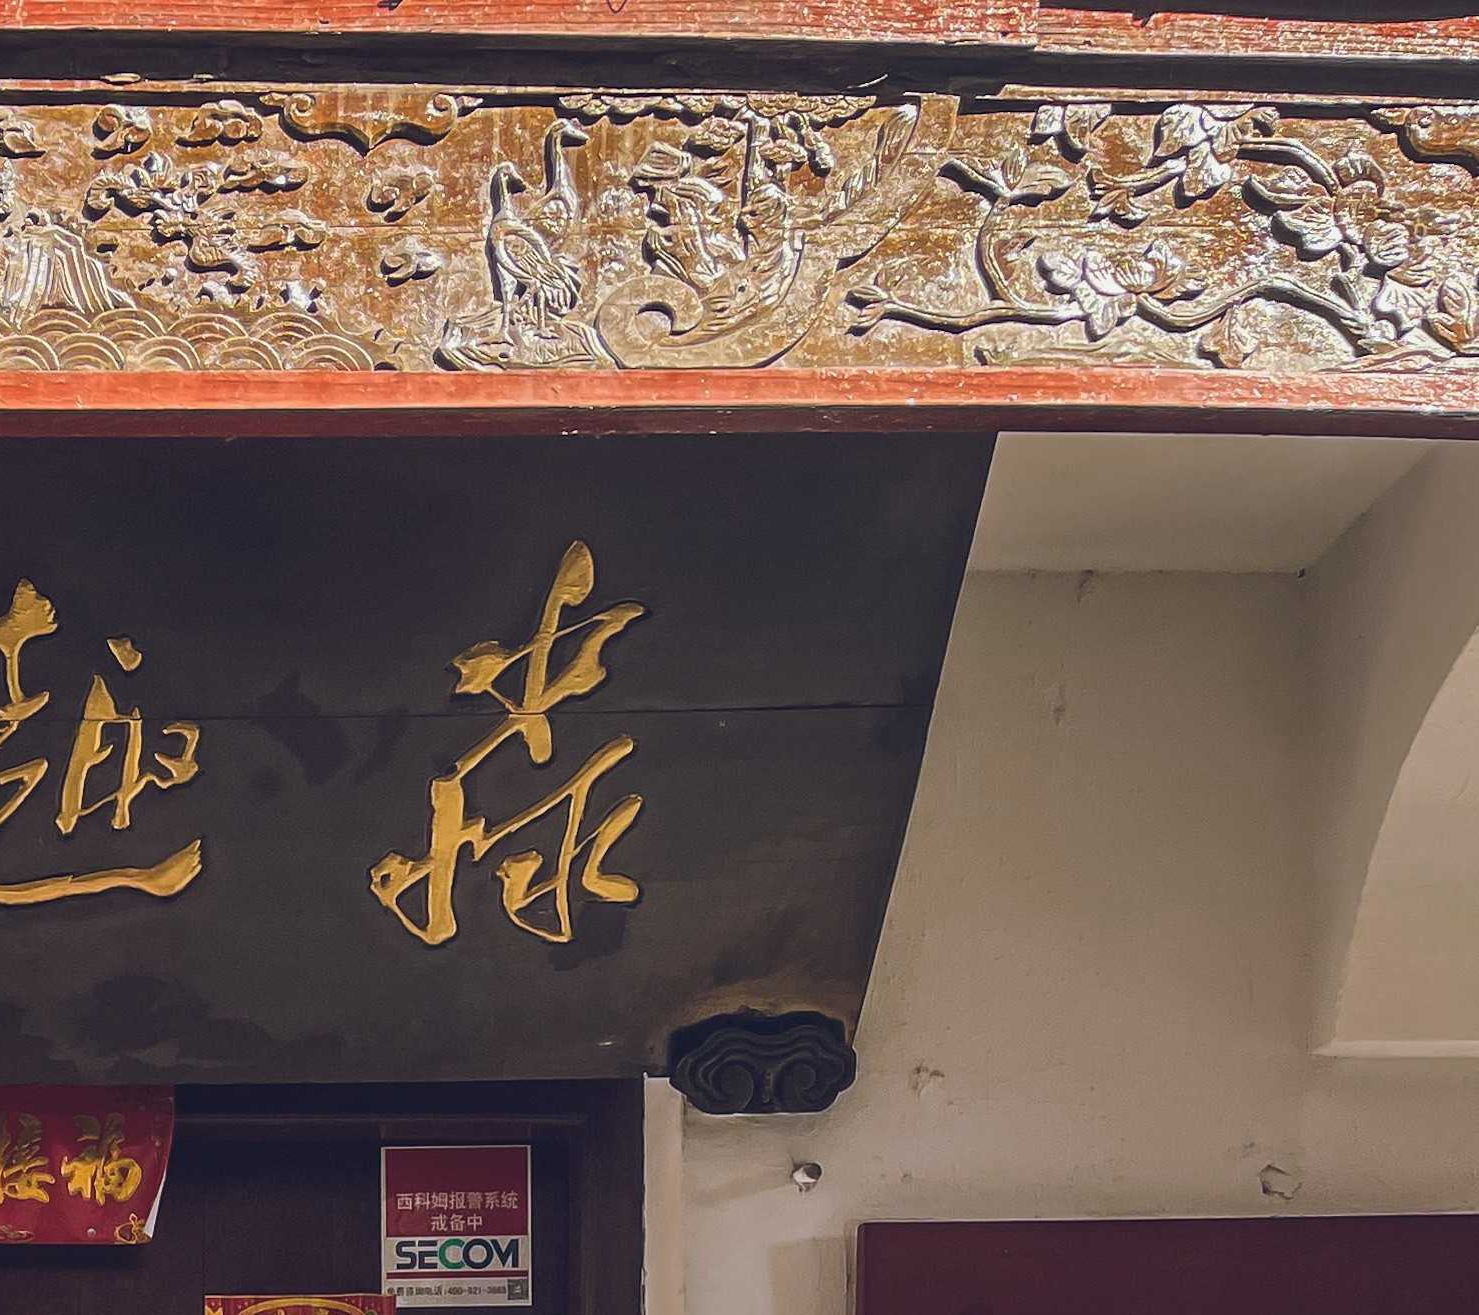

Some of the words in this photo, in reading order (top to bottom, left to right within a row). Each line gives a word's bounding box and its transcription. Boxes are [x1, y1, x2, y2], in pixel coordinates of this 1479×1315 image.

[396, 1190, 519, 1211] 西科姆报警系统
[431, 1213, 483, 1232] 戒备中
[395, 1238, 520, 1270] SECOM
